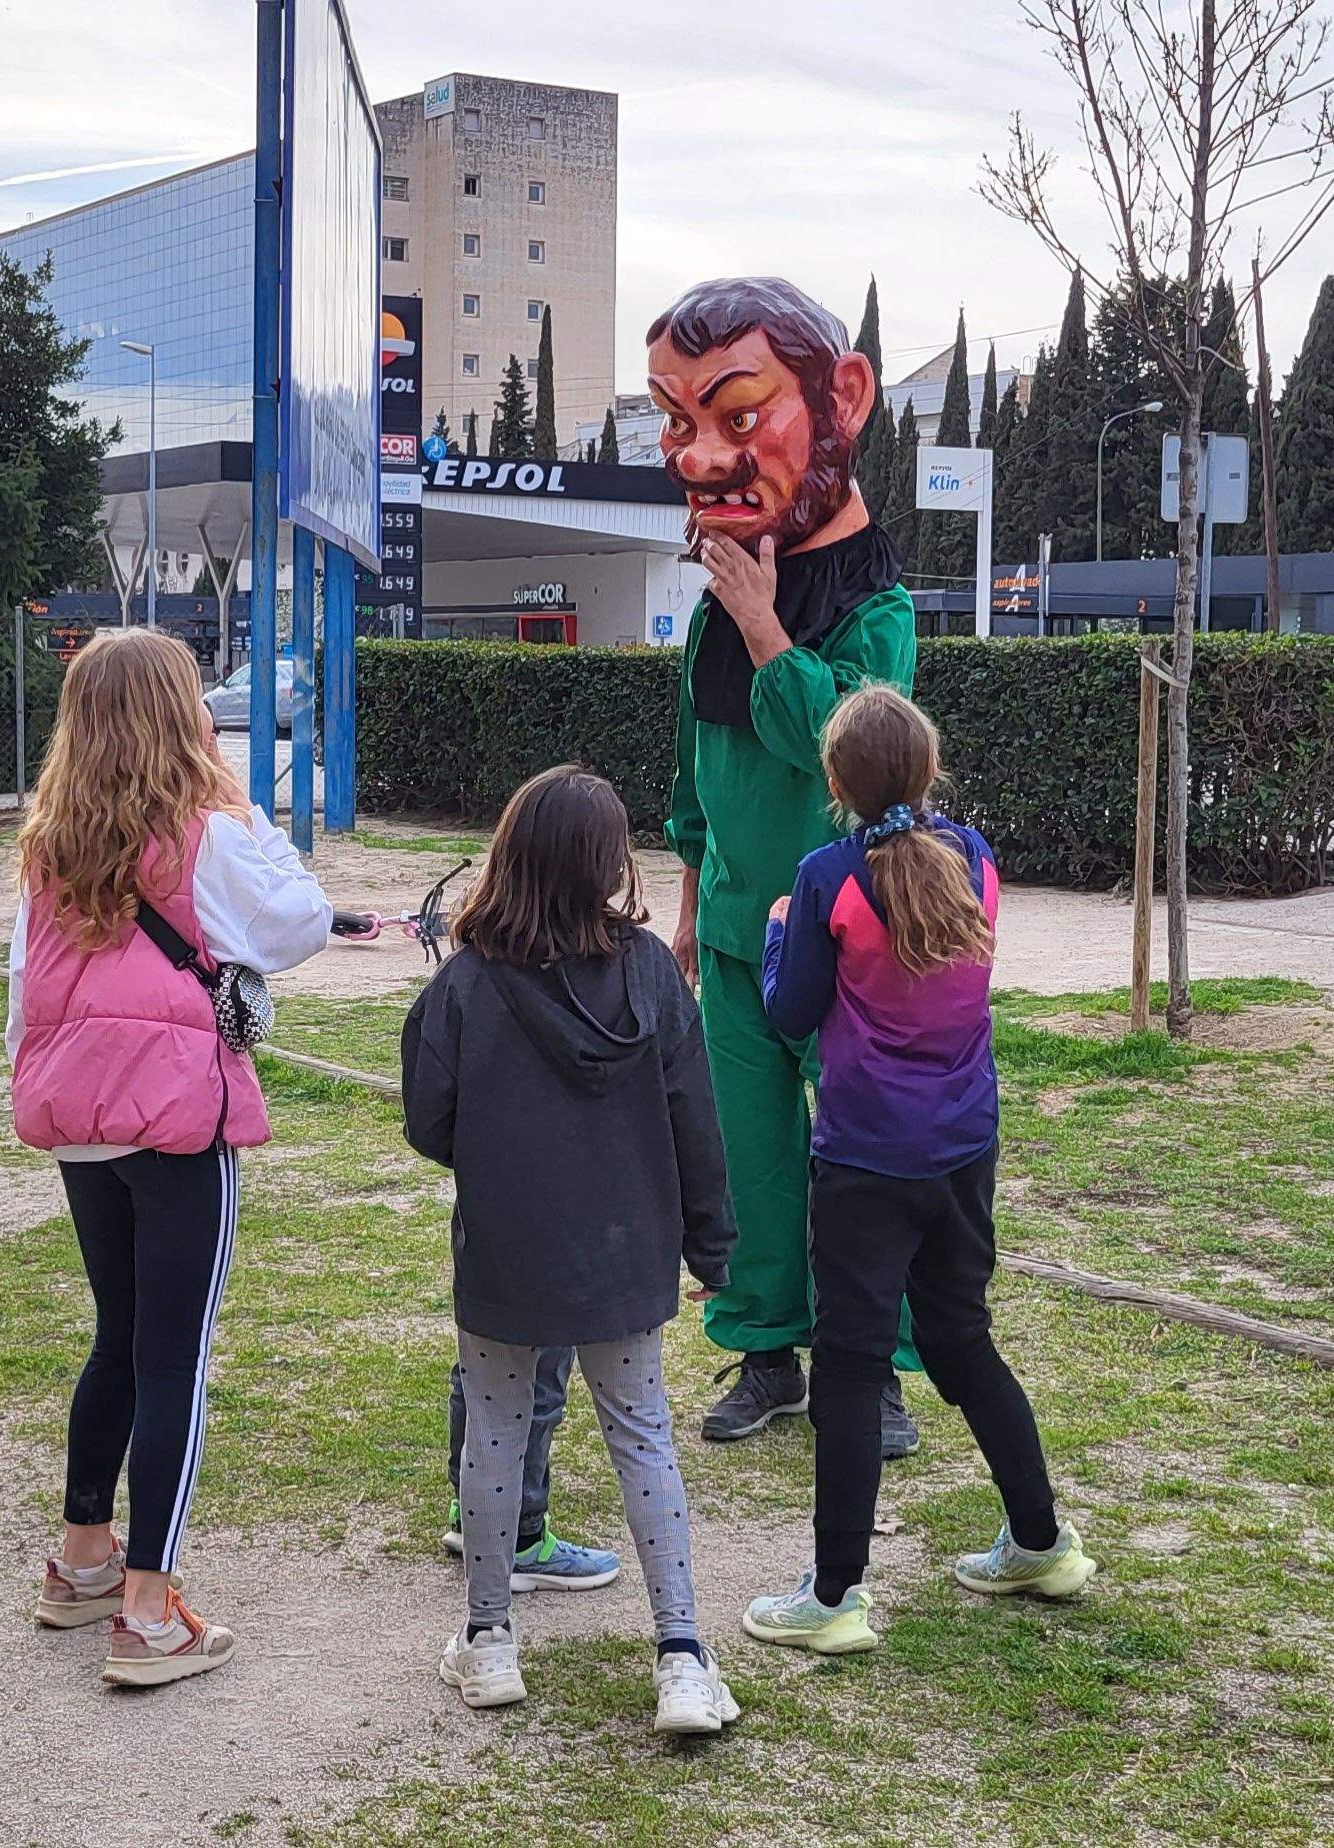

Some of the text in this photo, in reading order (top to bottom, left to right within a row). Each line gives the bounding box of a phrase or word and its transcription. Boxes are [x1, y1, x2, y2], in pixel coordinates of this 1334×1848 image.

[426, 82, 450, 106] salud
[381, 378, 416, 393] SOL
[380, 438, 414, 455] COR
[928, 474, 960, 491] Klin
[381, 513, 414, 528] .559
[381, 544, 414, 559] .649
[1138, 599, 1146, 613] 2
